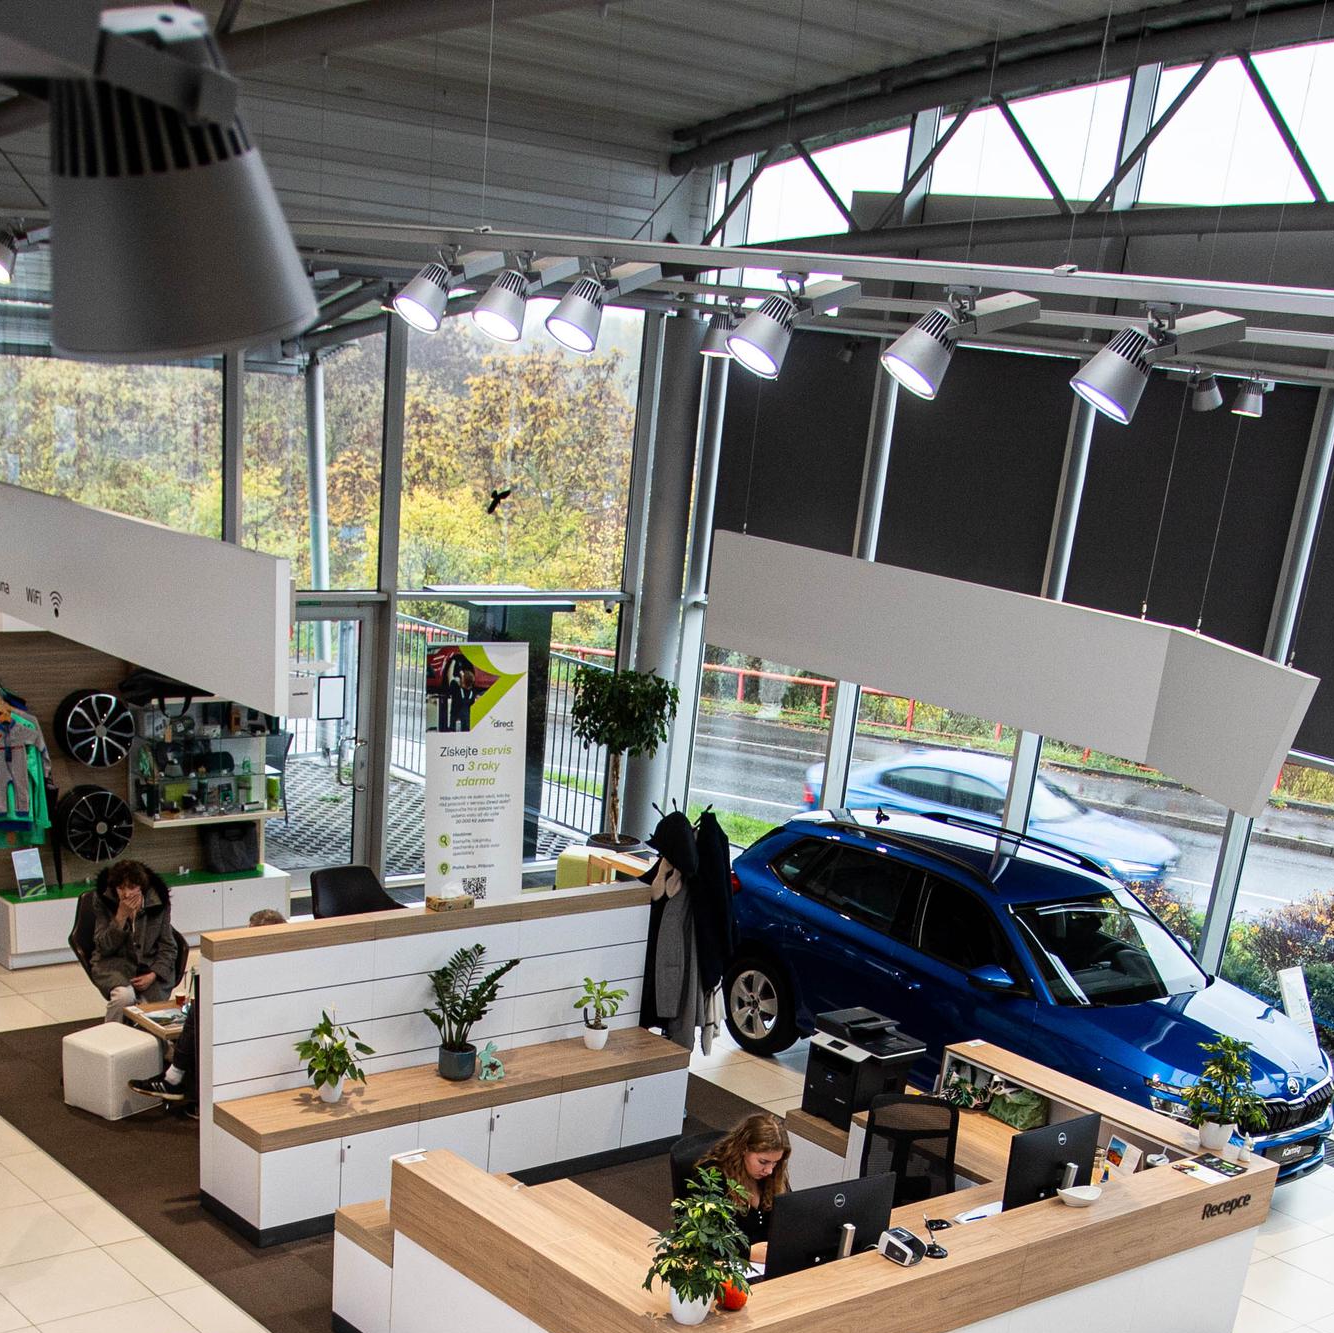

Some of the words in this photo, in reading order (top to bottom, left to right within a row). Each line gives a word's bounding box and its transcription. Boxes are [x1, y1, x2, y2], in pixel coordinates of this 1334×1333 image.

[25, 585, 42, 607] WiFi
[493, 720, 514, 728] direct
[481, 744, 513, 756] servis
[452, 763, 465, 772] na
[468, 760, 475, 771] 3
[477, 760, 500, 773] roky
[456, 776, 496, 787] zdarma
[1201, 1193, 1251, 1220] Recepce
